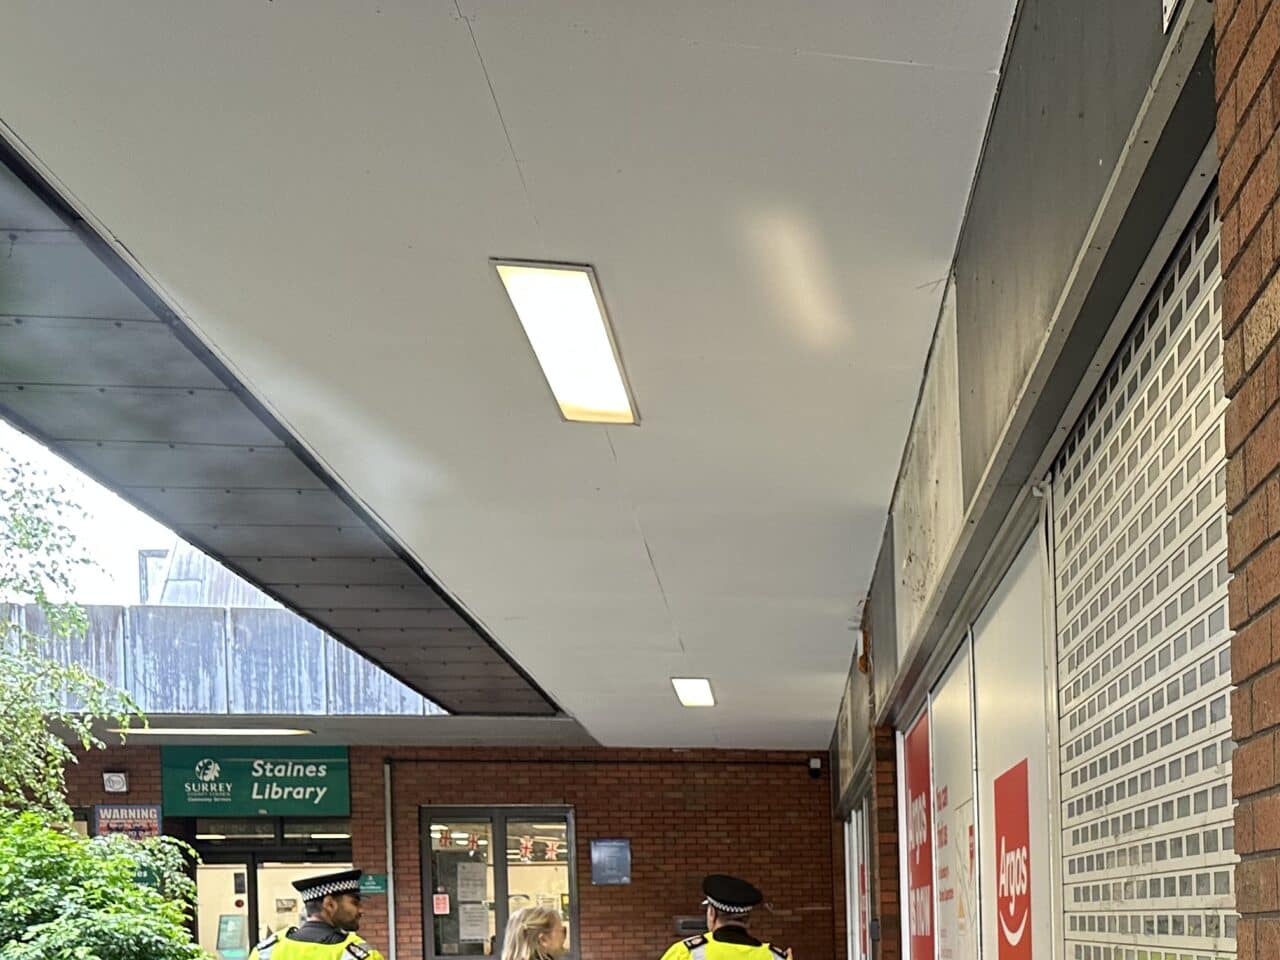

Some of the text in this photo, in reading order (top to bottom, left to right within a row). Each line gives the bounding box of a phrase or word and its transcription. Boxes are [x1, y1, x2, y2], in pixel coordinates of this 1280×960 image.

[251, 759, 328, 778] Staines
[184, 782, 233, 793] SURREY
[251, 782, 328, 804] Library
[99, 807, 159, 820] WARNING
[907, 788, 927, 865] Argos
[999, 835, 1028, 917] Argos
[916, 886, 931, 936] now
